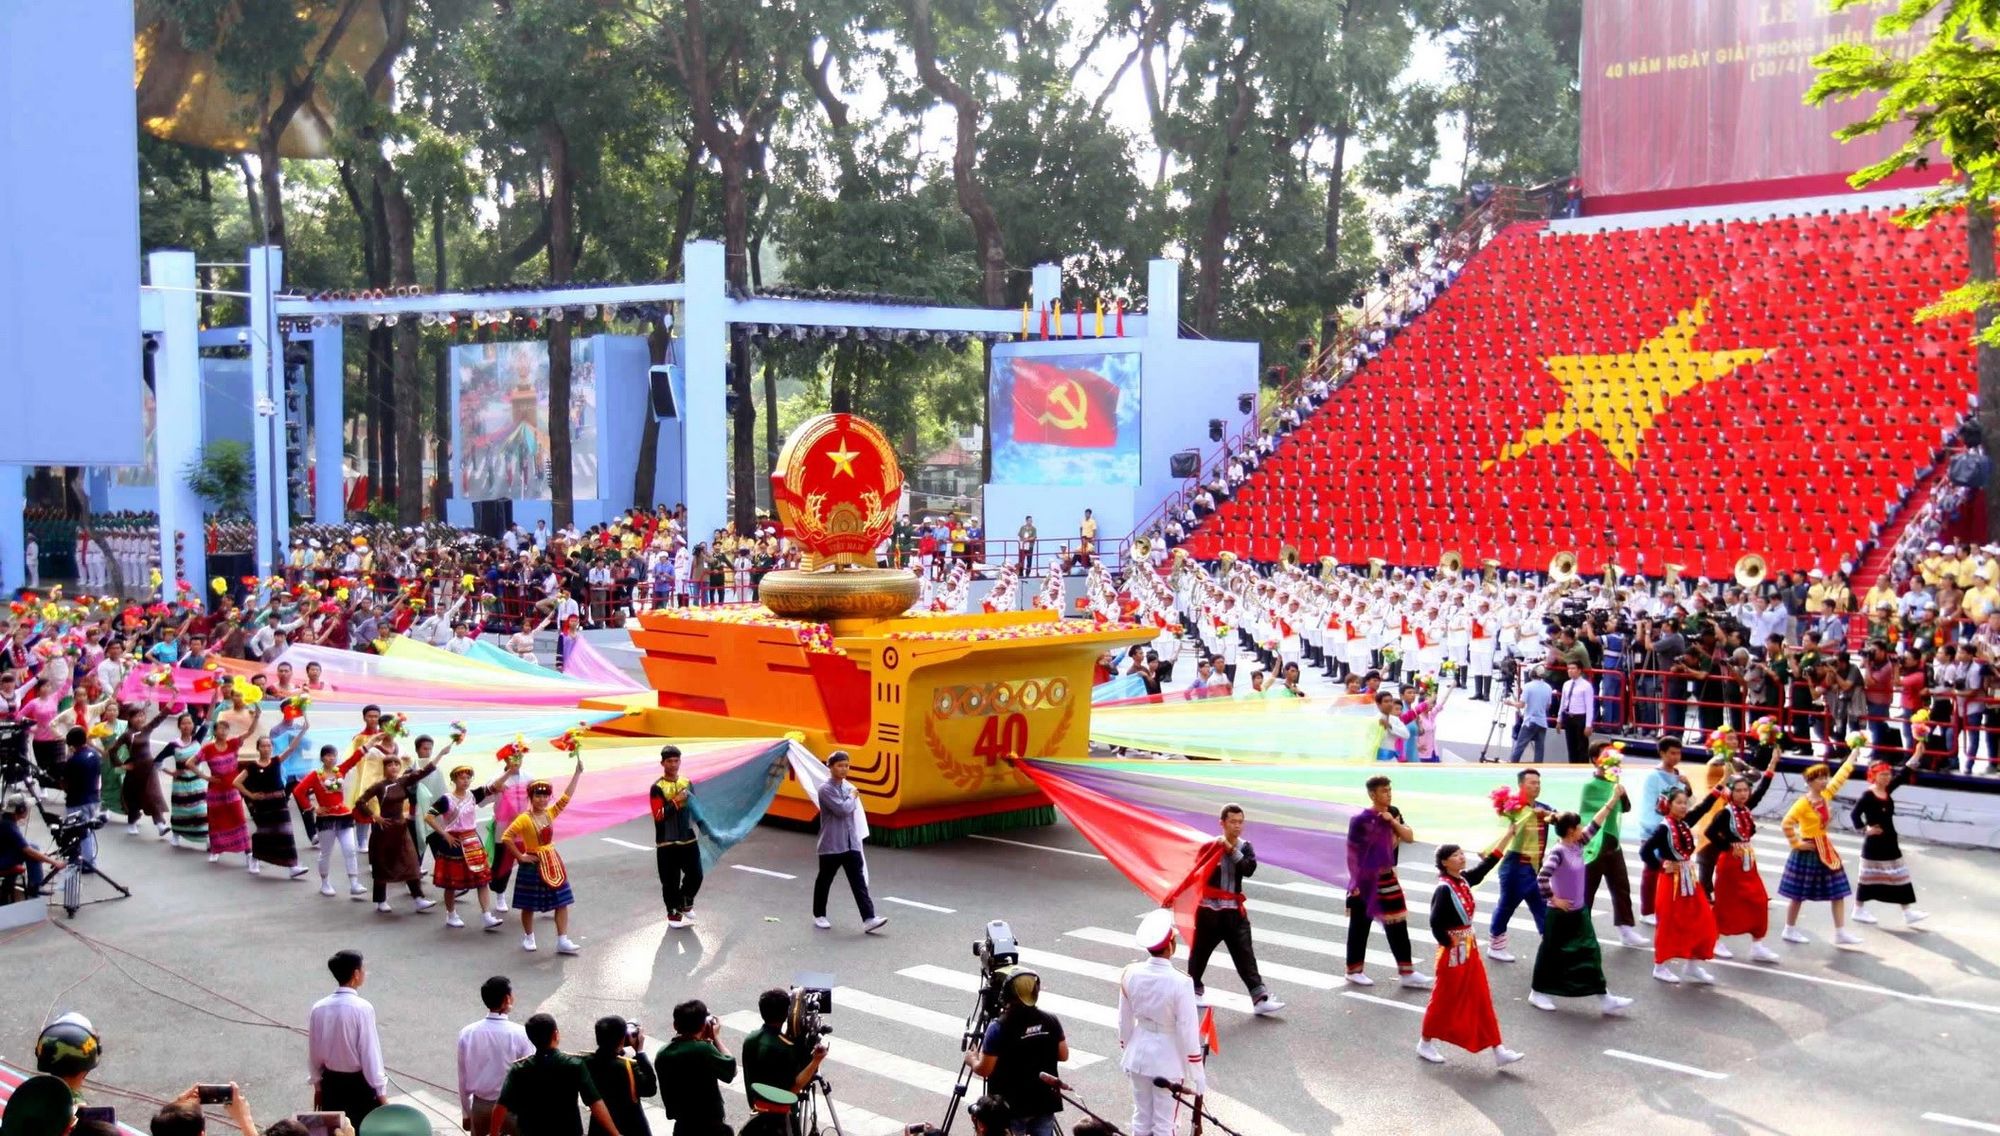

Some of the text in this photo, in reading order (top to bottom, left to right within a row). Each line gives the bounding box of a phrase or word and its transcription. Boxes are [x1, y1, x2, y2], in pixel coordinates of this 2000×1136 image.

[1606, 62, 1624, 78] 40
[1628, 56, 1661, 76] NĂM
[1667, 48, 1709, 72] NGÀY
[974, 713, 1028, 767] 40
